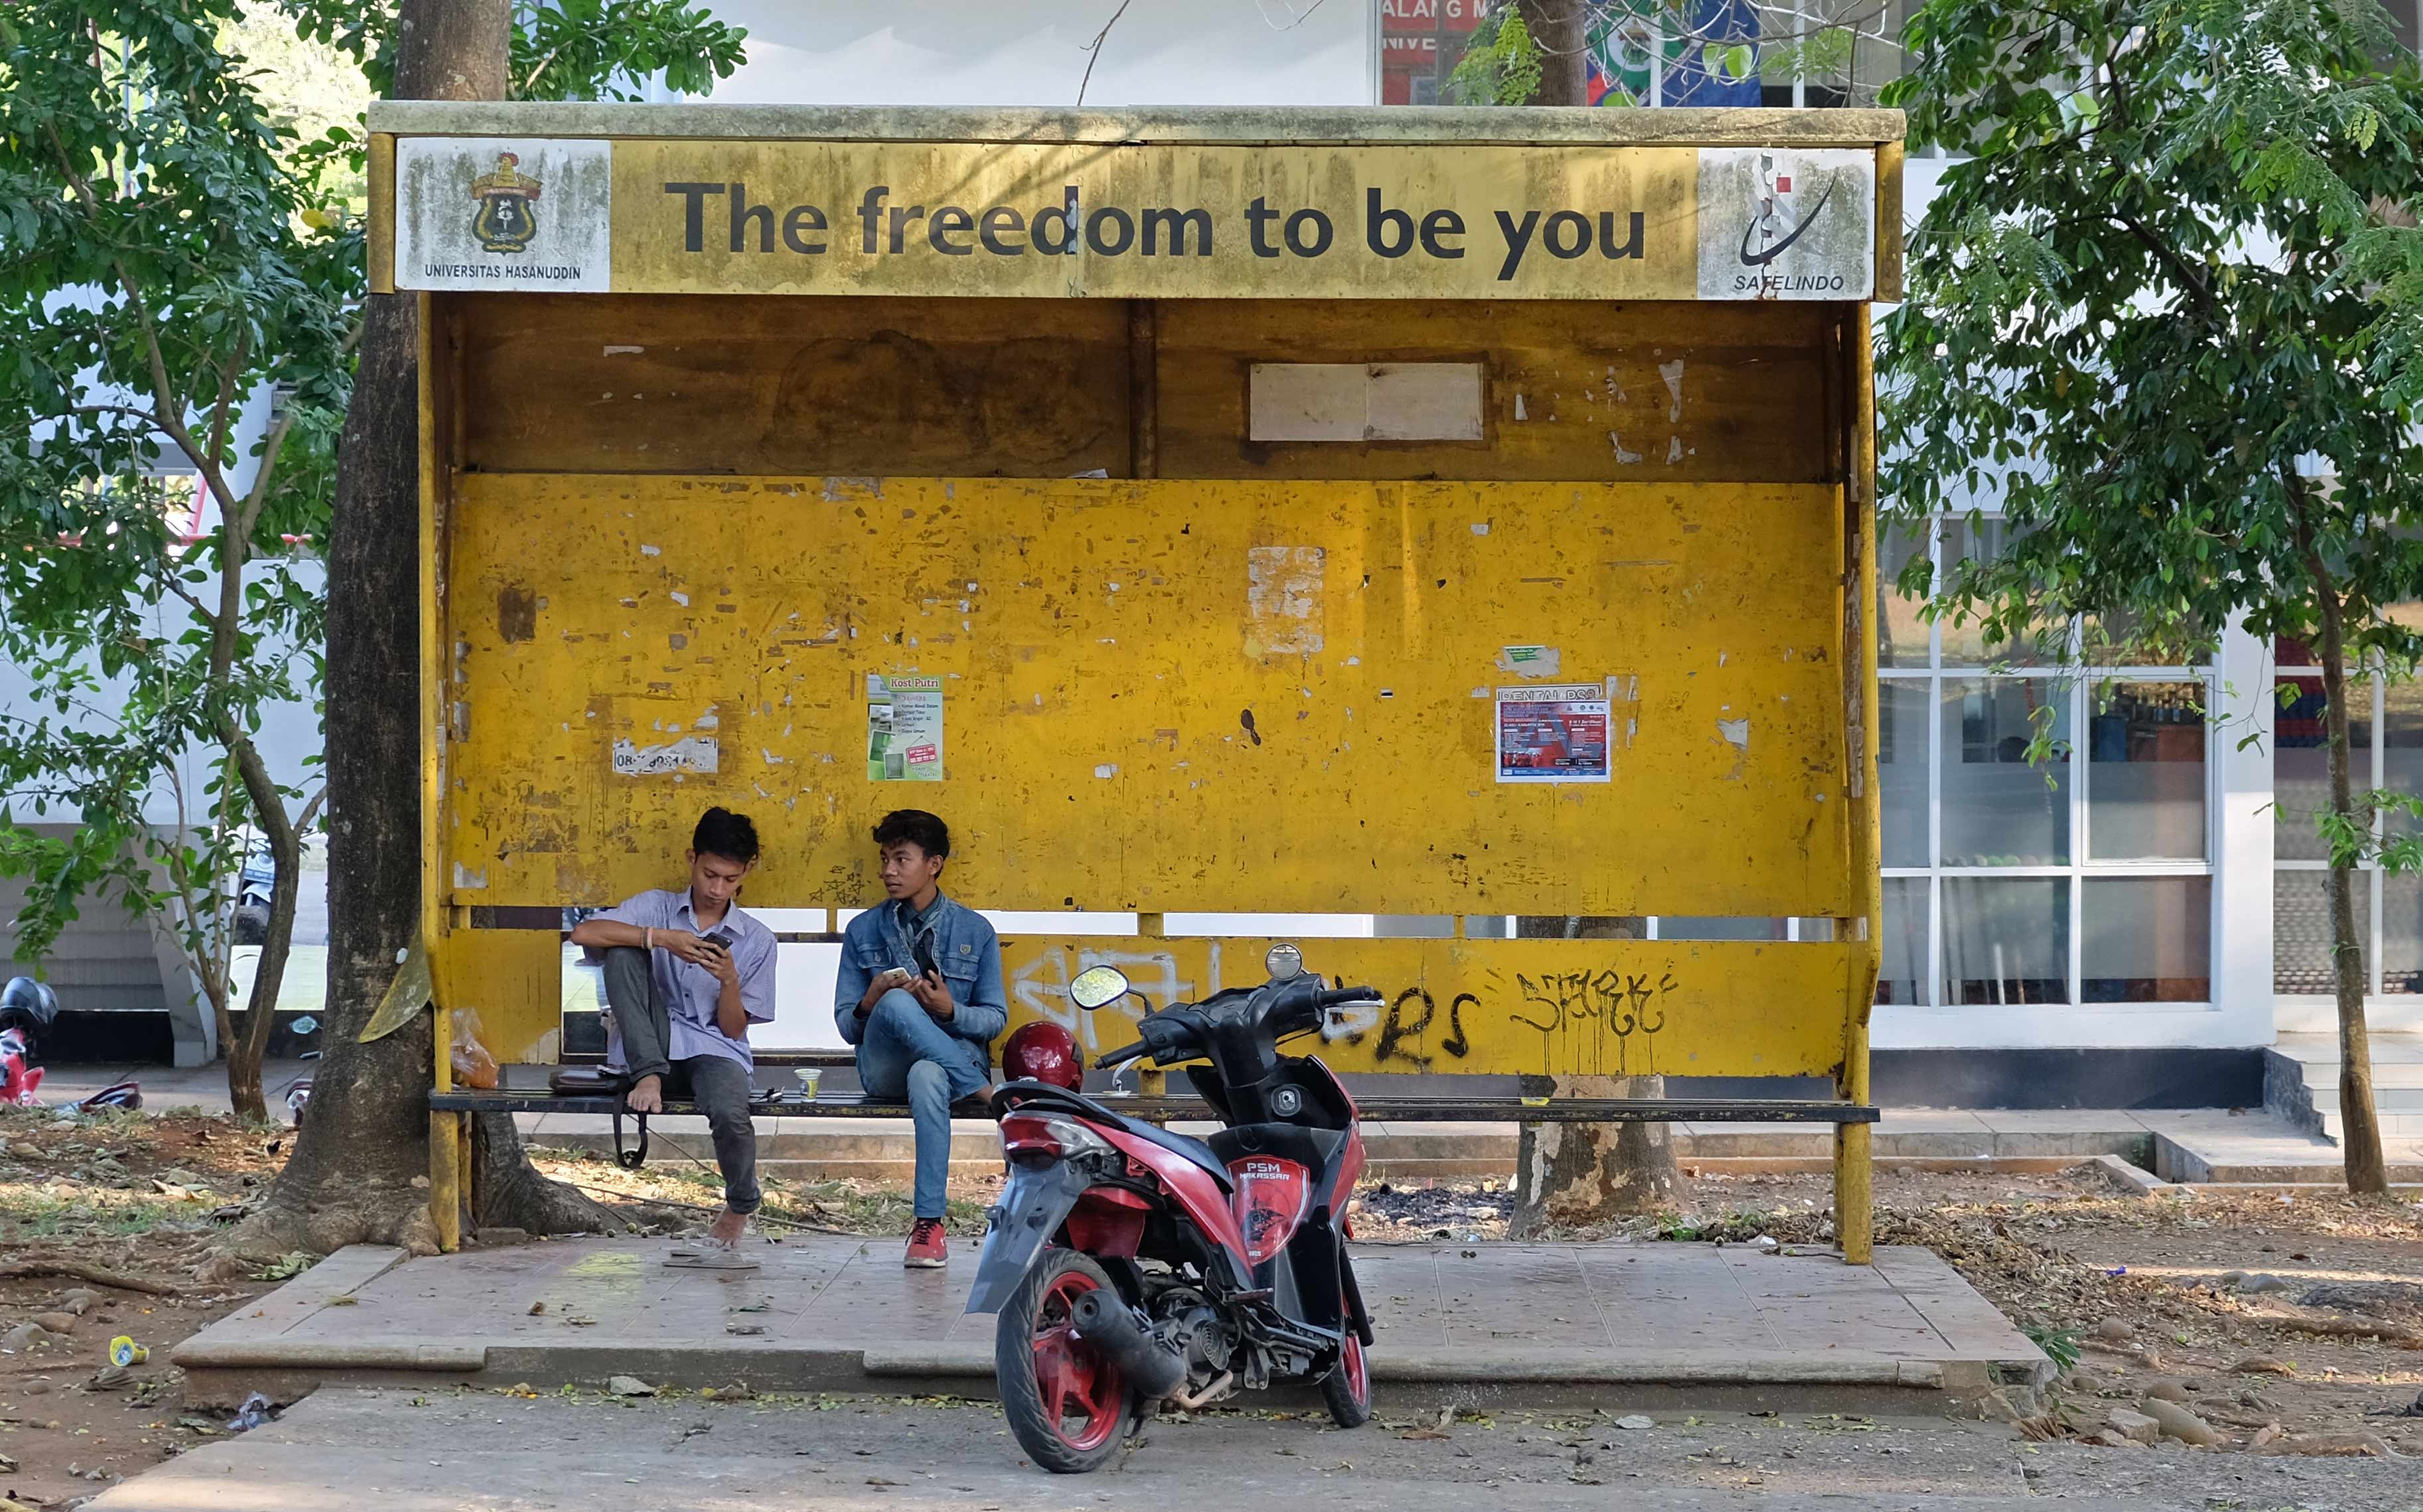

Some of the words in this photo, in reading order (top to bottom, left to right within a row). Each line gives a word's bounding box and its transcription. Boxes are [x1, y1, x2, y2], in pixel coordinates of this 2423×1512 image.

[665, 183, 828, 255] The
[857, 186, 1213, 257] freedom
[1245, 197, 1334, 259] to
[1367, 188, 1466, 259] be
[1494, 210, 1645, 281] you
[425, 264, 500, 278] UNIVERSITAS
[505, 265, 581, 279] HASANUDDIN
[1734, 275, 1844, 291] SATELINDO
[891, 678, 912, 687] Kost
[914, 678, 939, 687] Putri
[1246, 1162, 1280, 1172] PSM
[1239, 1172, 1290, 1181] MAKASSAR
